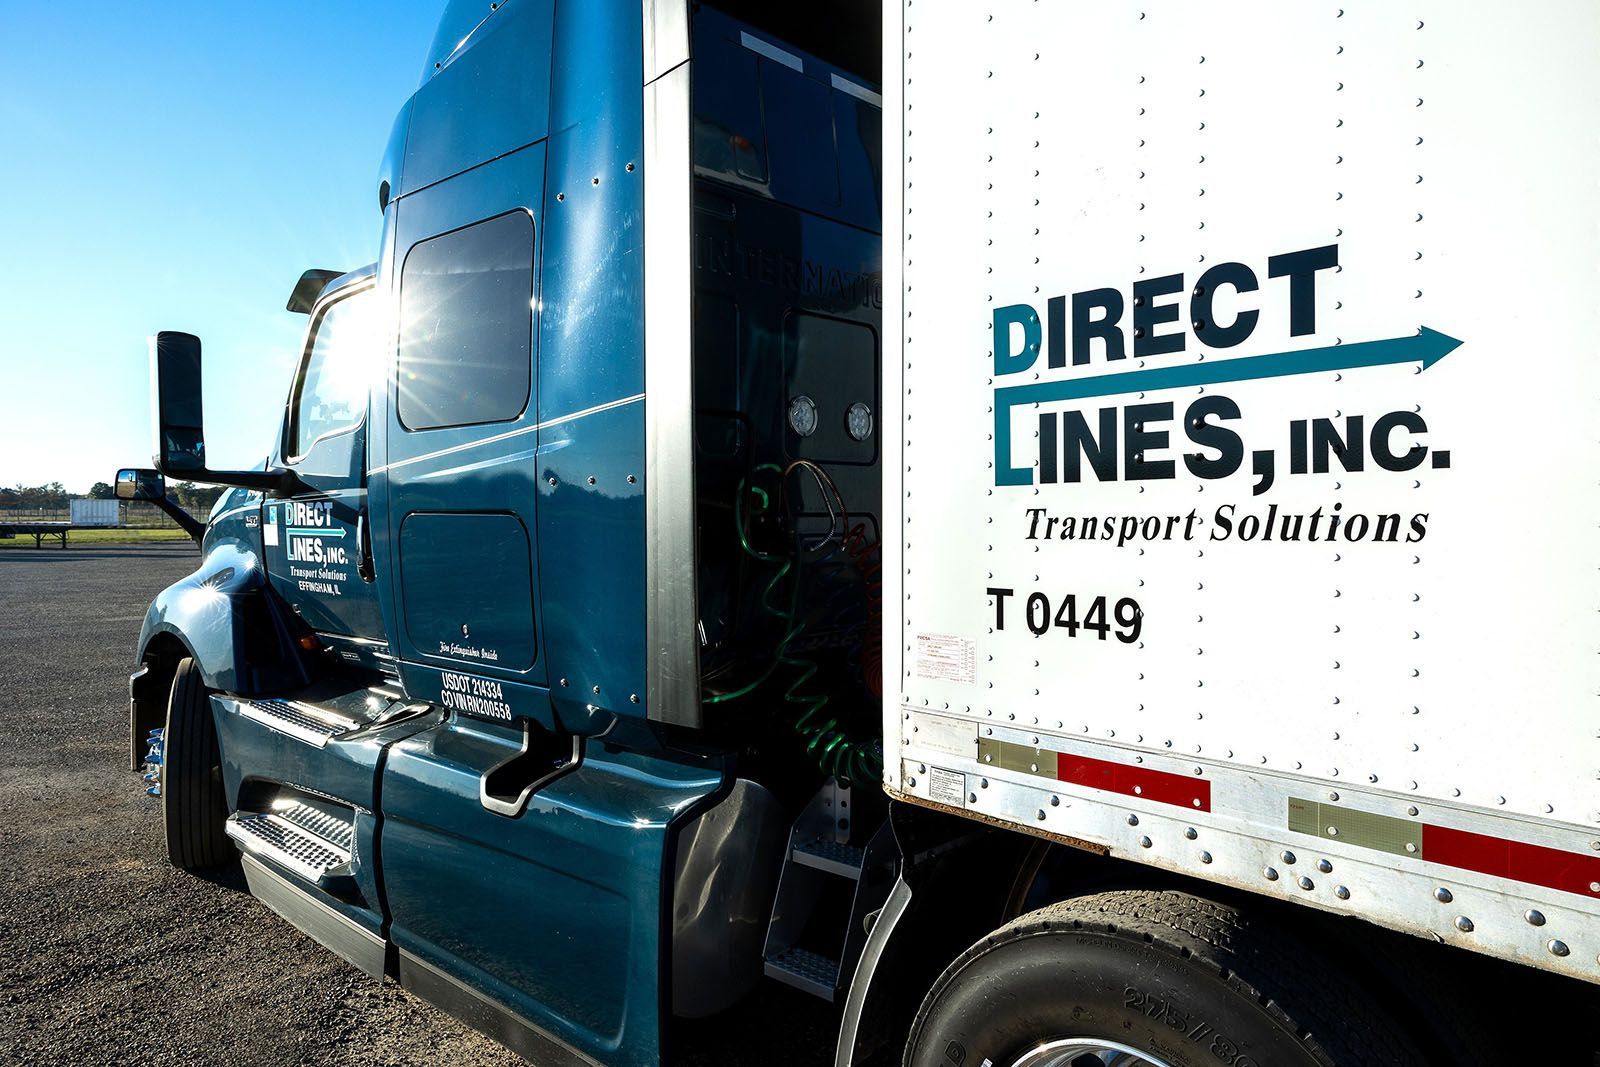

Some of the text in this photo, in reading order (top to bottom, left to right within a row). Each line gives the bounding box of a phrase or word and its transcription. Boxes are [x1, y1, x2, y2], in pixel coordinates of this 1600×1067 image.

[993, 244, 1338, 377] DIRECT
[994, 388, 1450, 496] LINES, INC.
[285, 502, 333, 527] DIRECT
[1025, 503, 1429, 547] Transport Solutions
[286, 528, 349, 568] LINES, INC.
[290, 566, 347, 581] Transport Solutions
[298, 580, 335, 596] EFFINGHAM,
[986, 587, 1143, 644] T 0449
[441, 672, 503, 700] USDOT 214334
